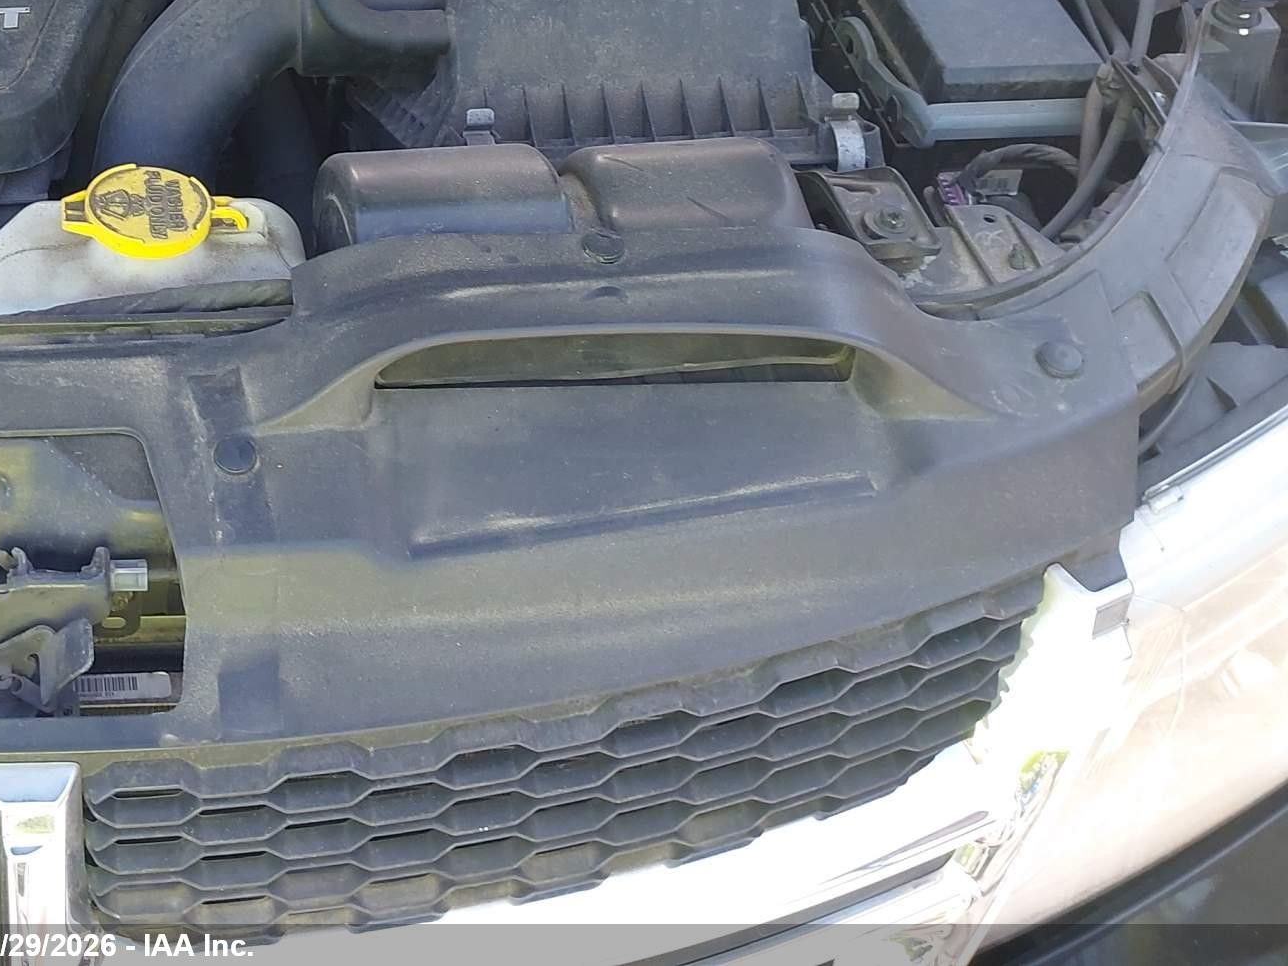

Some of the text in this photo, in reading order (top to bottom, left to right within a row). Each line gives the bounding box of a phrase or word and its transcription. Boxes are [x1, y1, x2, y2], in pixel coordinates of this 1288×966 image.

[144, 170, 168, 240] FLUID ONLY
[165, 179, 188, 231] WASHER
